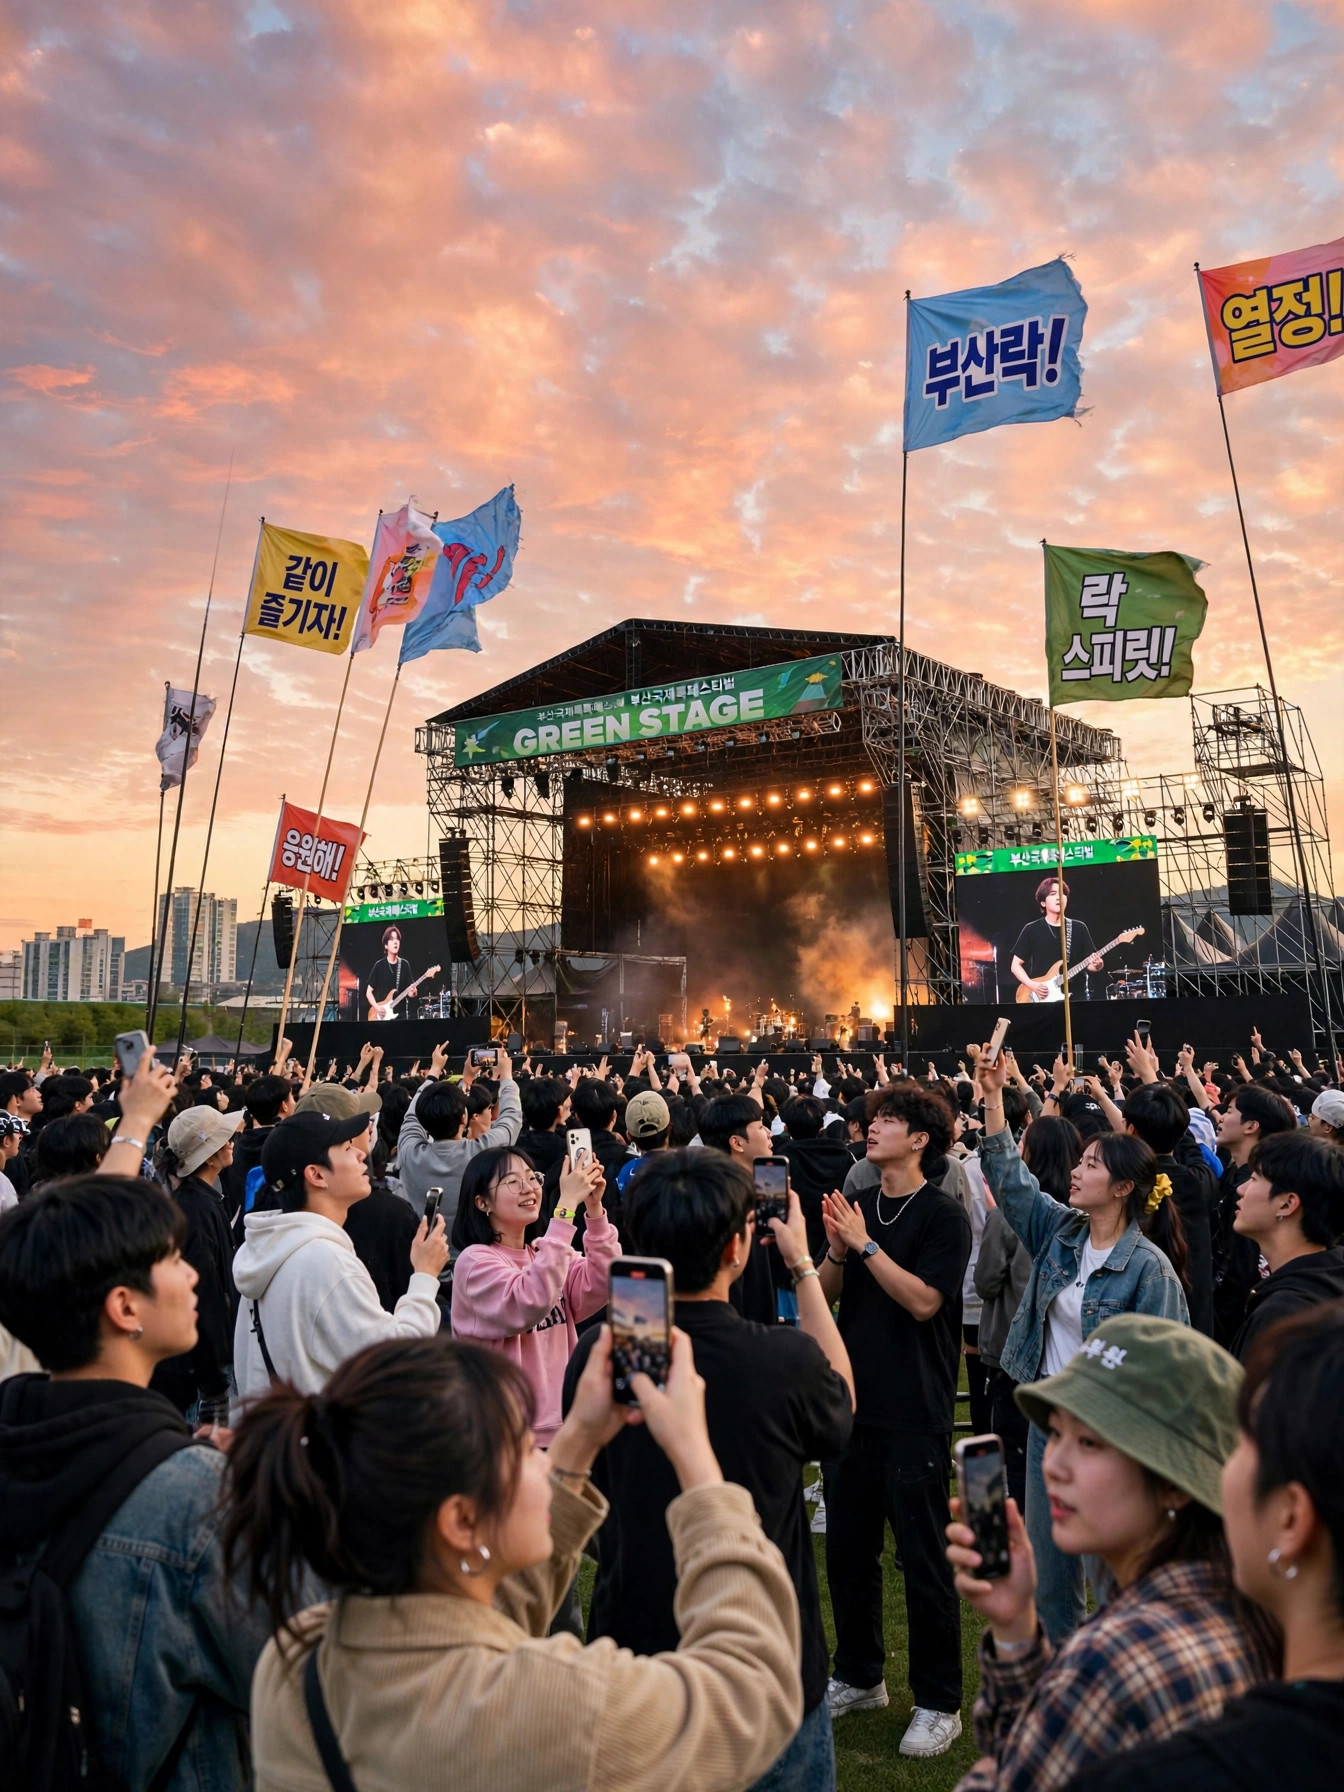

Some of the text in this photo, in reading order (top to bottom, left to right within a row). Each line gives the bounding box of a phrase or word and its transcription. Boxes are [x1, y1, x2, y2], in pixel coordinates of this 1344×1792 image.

[1221, 267, 1344, 363] 열정!
[923, 313, 1069, 410] 부산락!
[284, 555, 338, 597] 같이
[1080, 571, 1129, 628] 락
[257, 591, 347, 641] 즐기자!
[1061, 626, 1177, 684] 스피릿!
[513, 713, 631, 756] GREEN
[638, 688, 766, 739] STAGE
[281, 828, 346, 882] 응원해!
